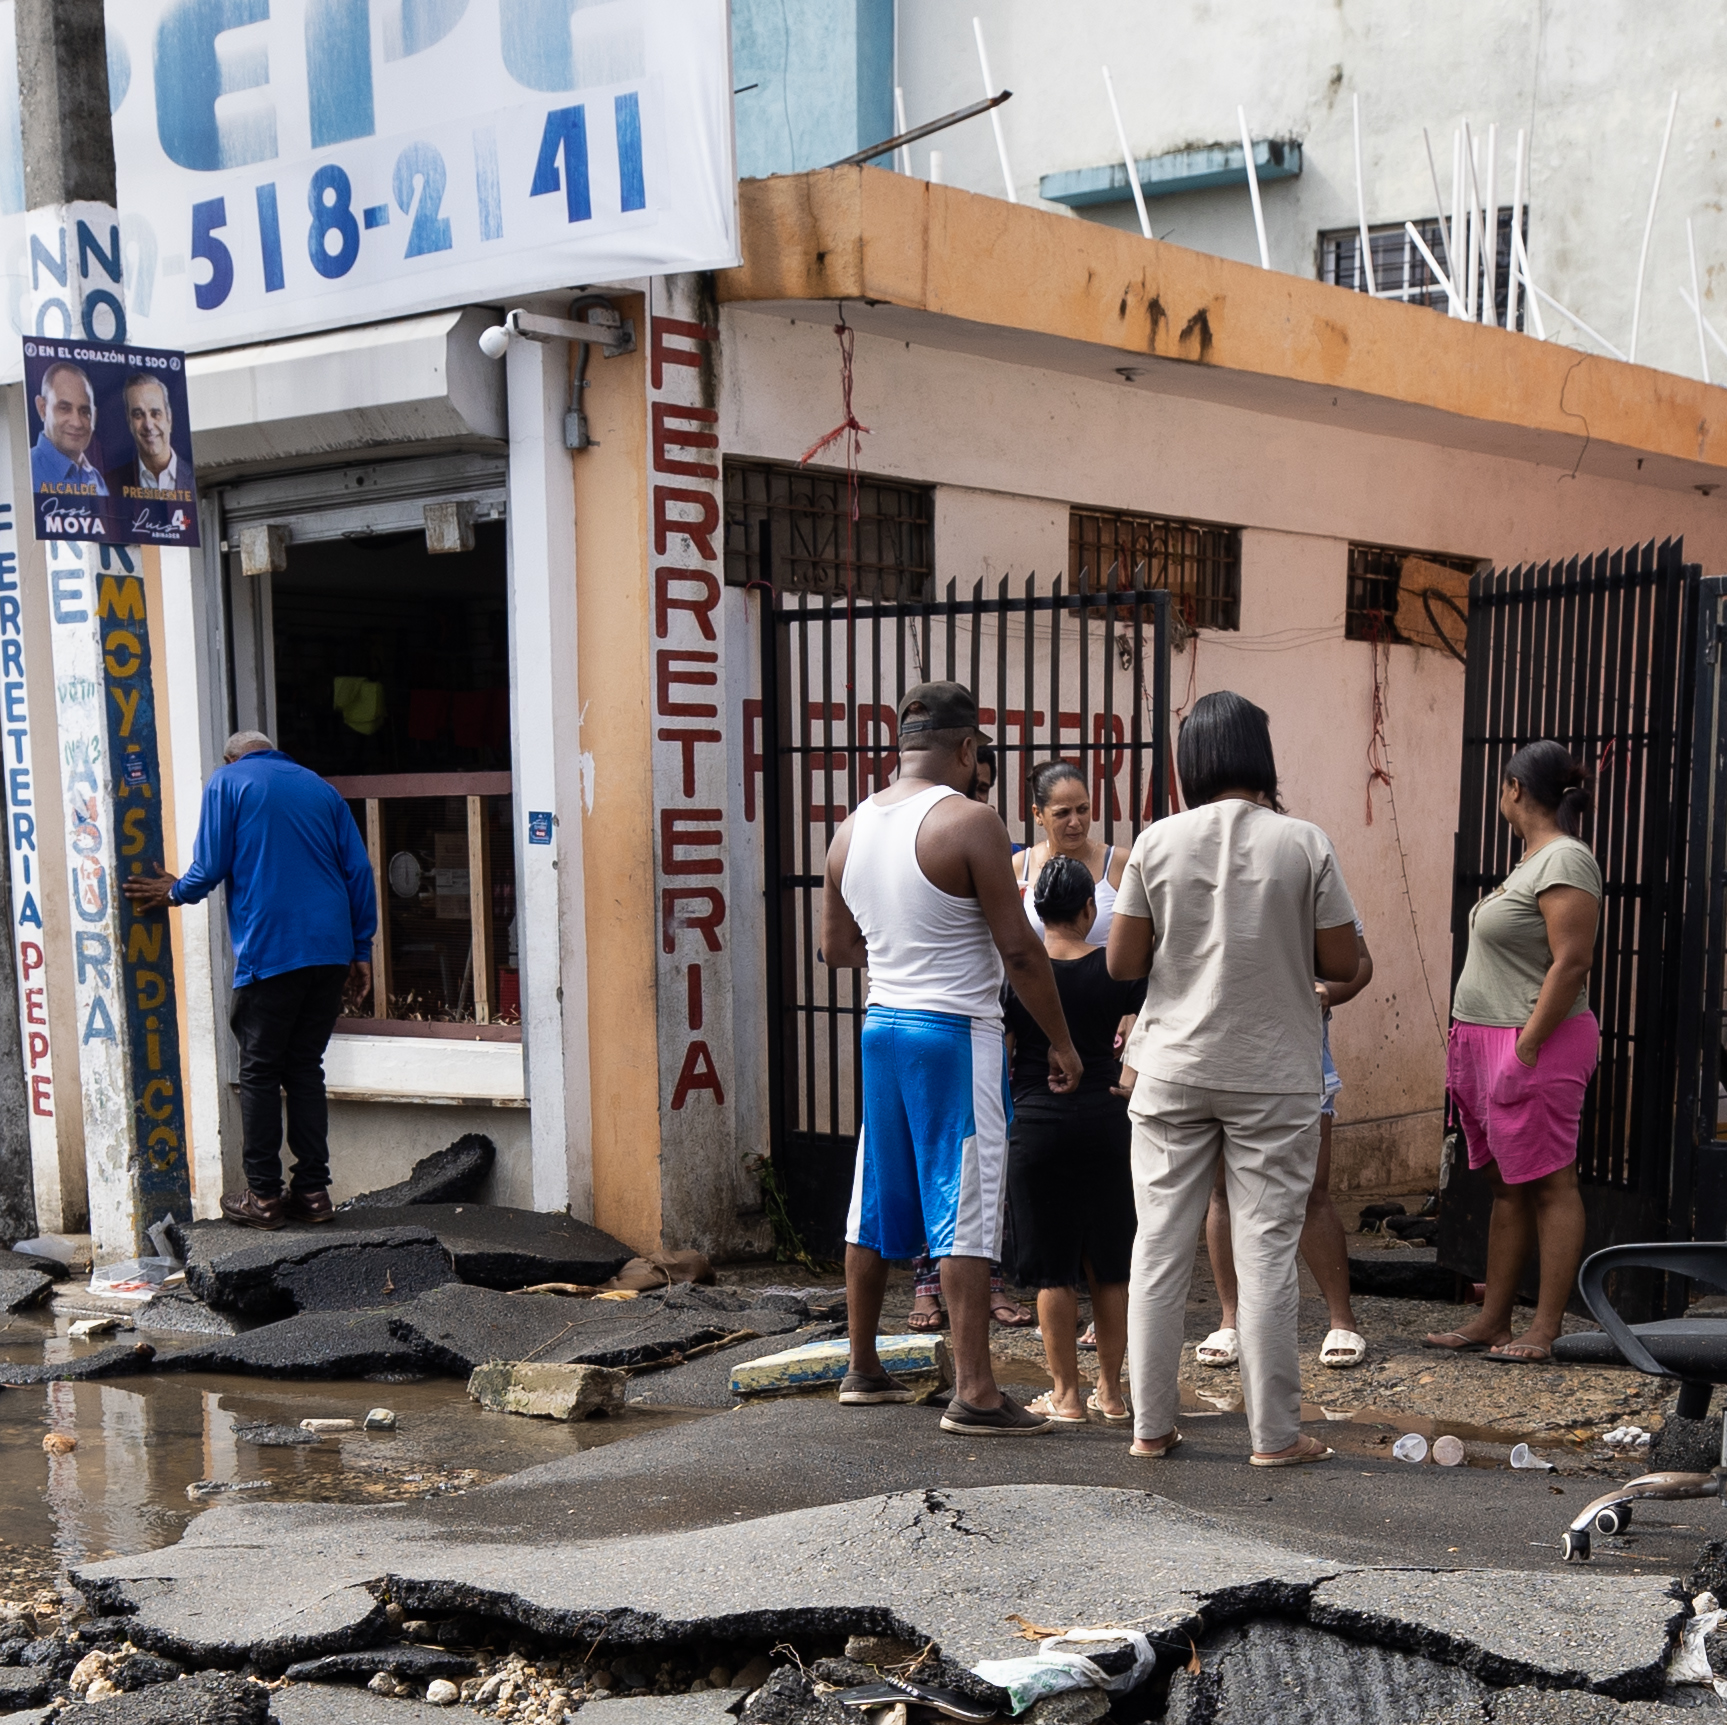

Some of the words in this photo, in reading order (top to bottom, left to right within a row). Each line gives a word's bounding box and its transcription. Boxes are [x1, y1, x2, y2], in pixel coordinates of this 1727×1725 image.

[39, 345, 54, 357] EN
[58, 346, 72, 359] EL
[74, 348, 125, 364] CORAZÓN
[129, 354, 142, 366] DE
[145, 357, 167, 368] SDO
[40, 482, 97, 496] ALCALDE
[123, 486, 192, 502] PRESIDENTE
[46, 517, 106, 535] MOYA
[650, 316, 726, 1110] FERRETERIA
[21, 941, 55, 1118] PEPE
